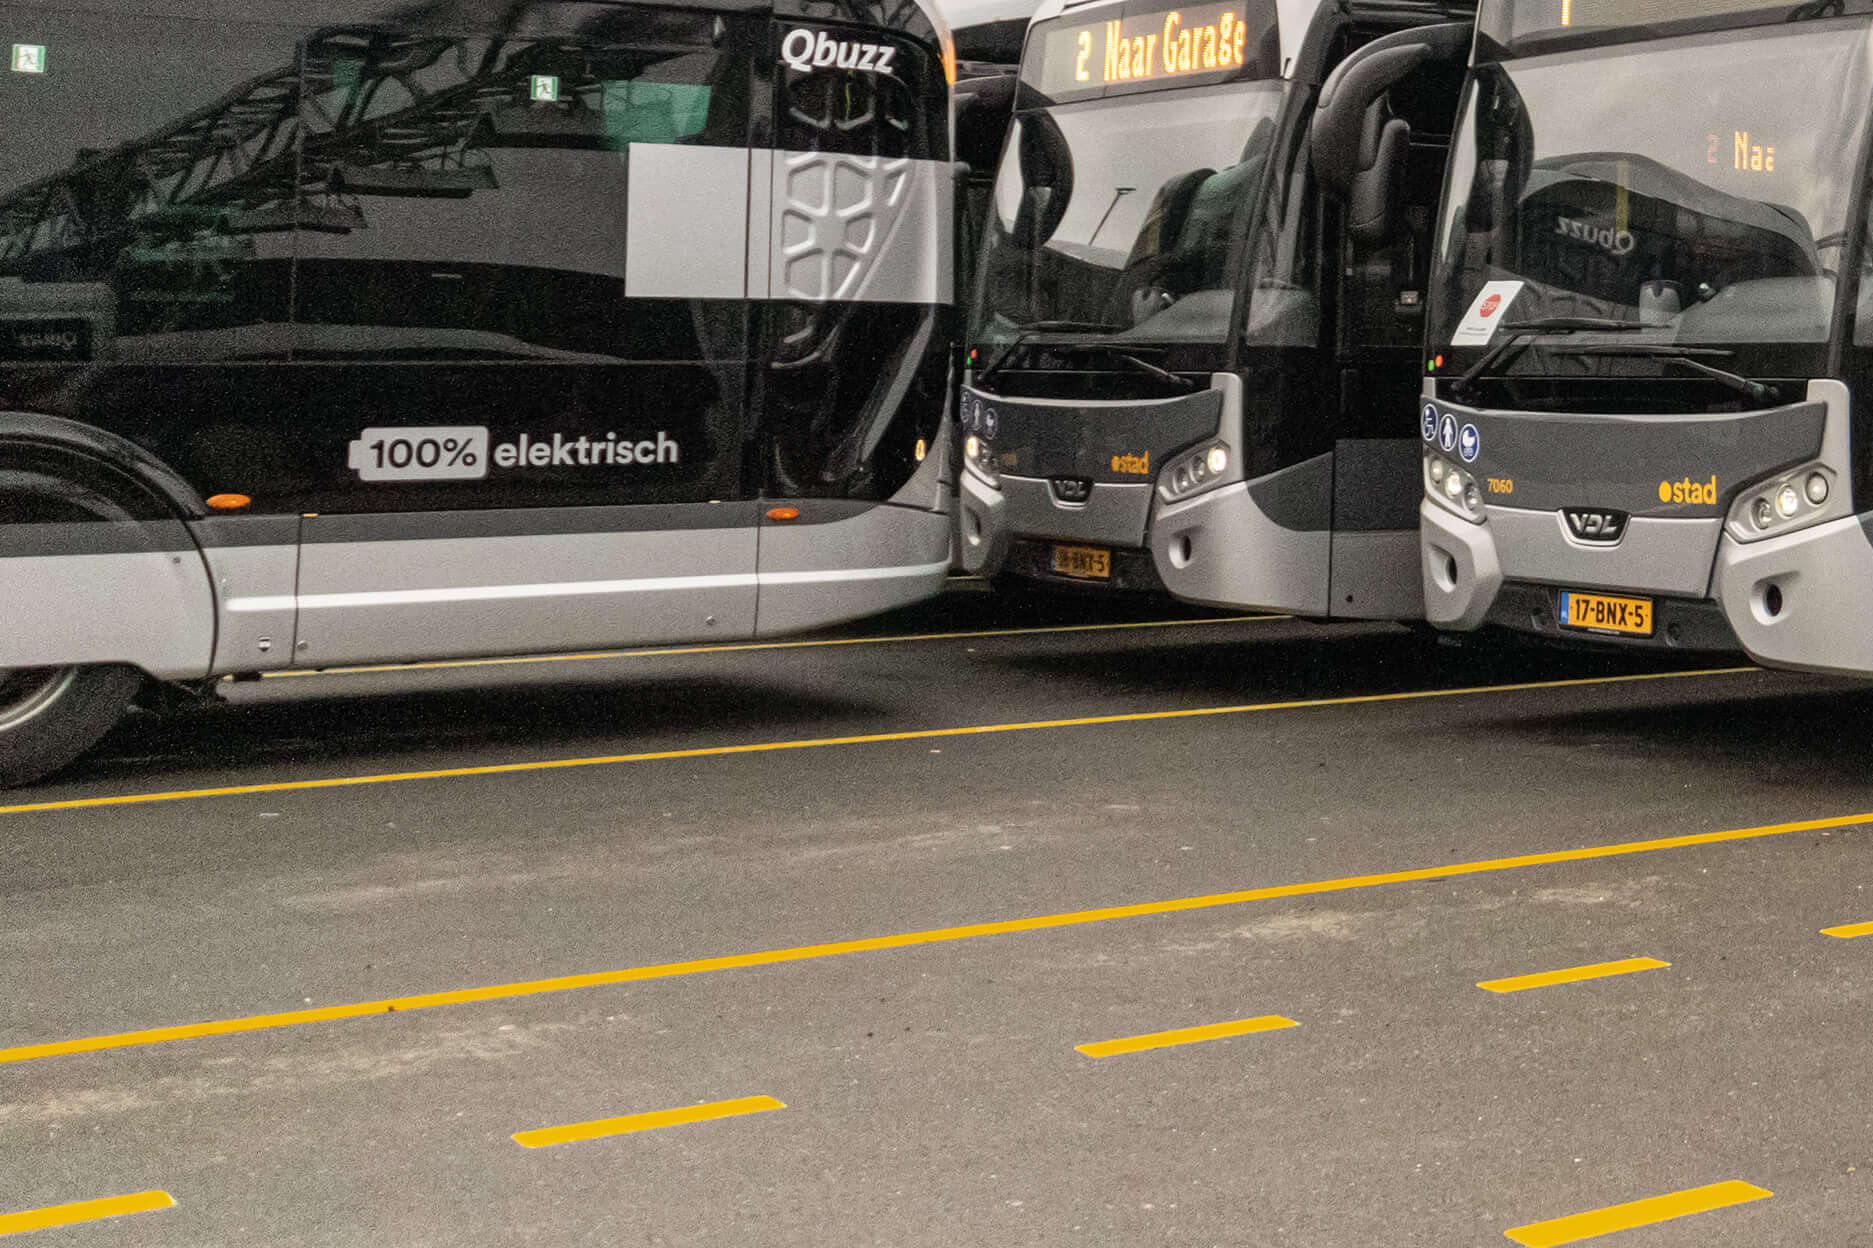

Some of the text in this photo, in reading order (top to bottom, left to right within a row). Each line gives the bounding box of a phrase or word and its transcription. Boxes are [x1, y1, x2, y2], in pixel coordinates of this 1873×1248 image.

[781, 28, 896, 73] Qbuzz
[1075, 10, 1247, 82] 2 Naar Garage
[370, 431, 680, 468] 100% elektrisch
[1488, 478, 1513, 494] 7060
[1672, 475, 1717, 505] stad
[1570, 513, 1617, 534] VDL
[1576, 599, 1644, 628] 17-BNX-5
